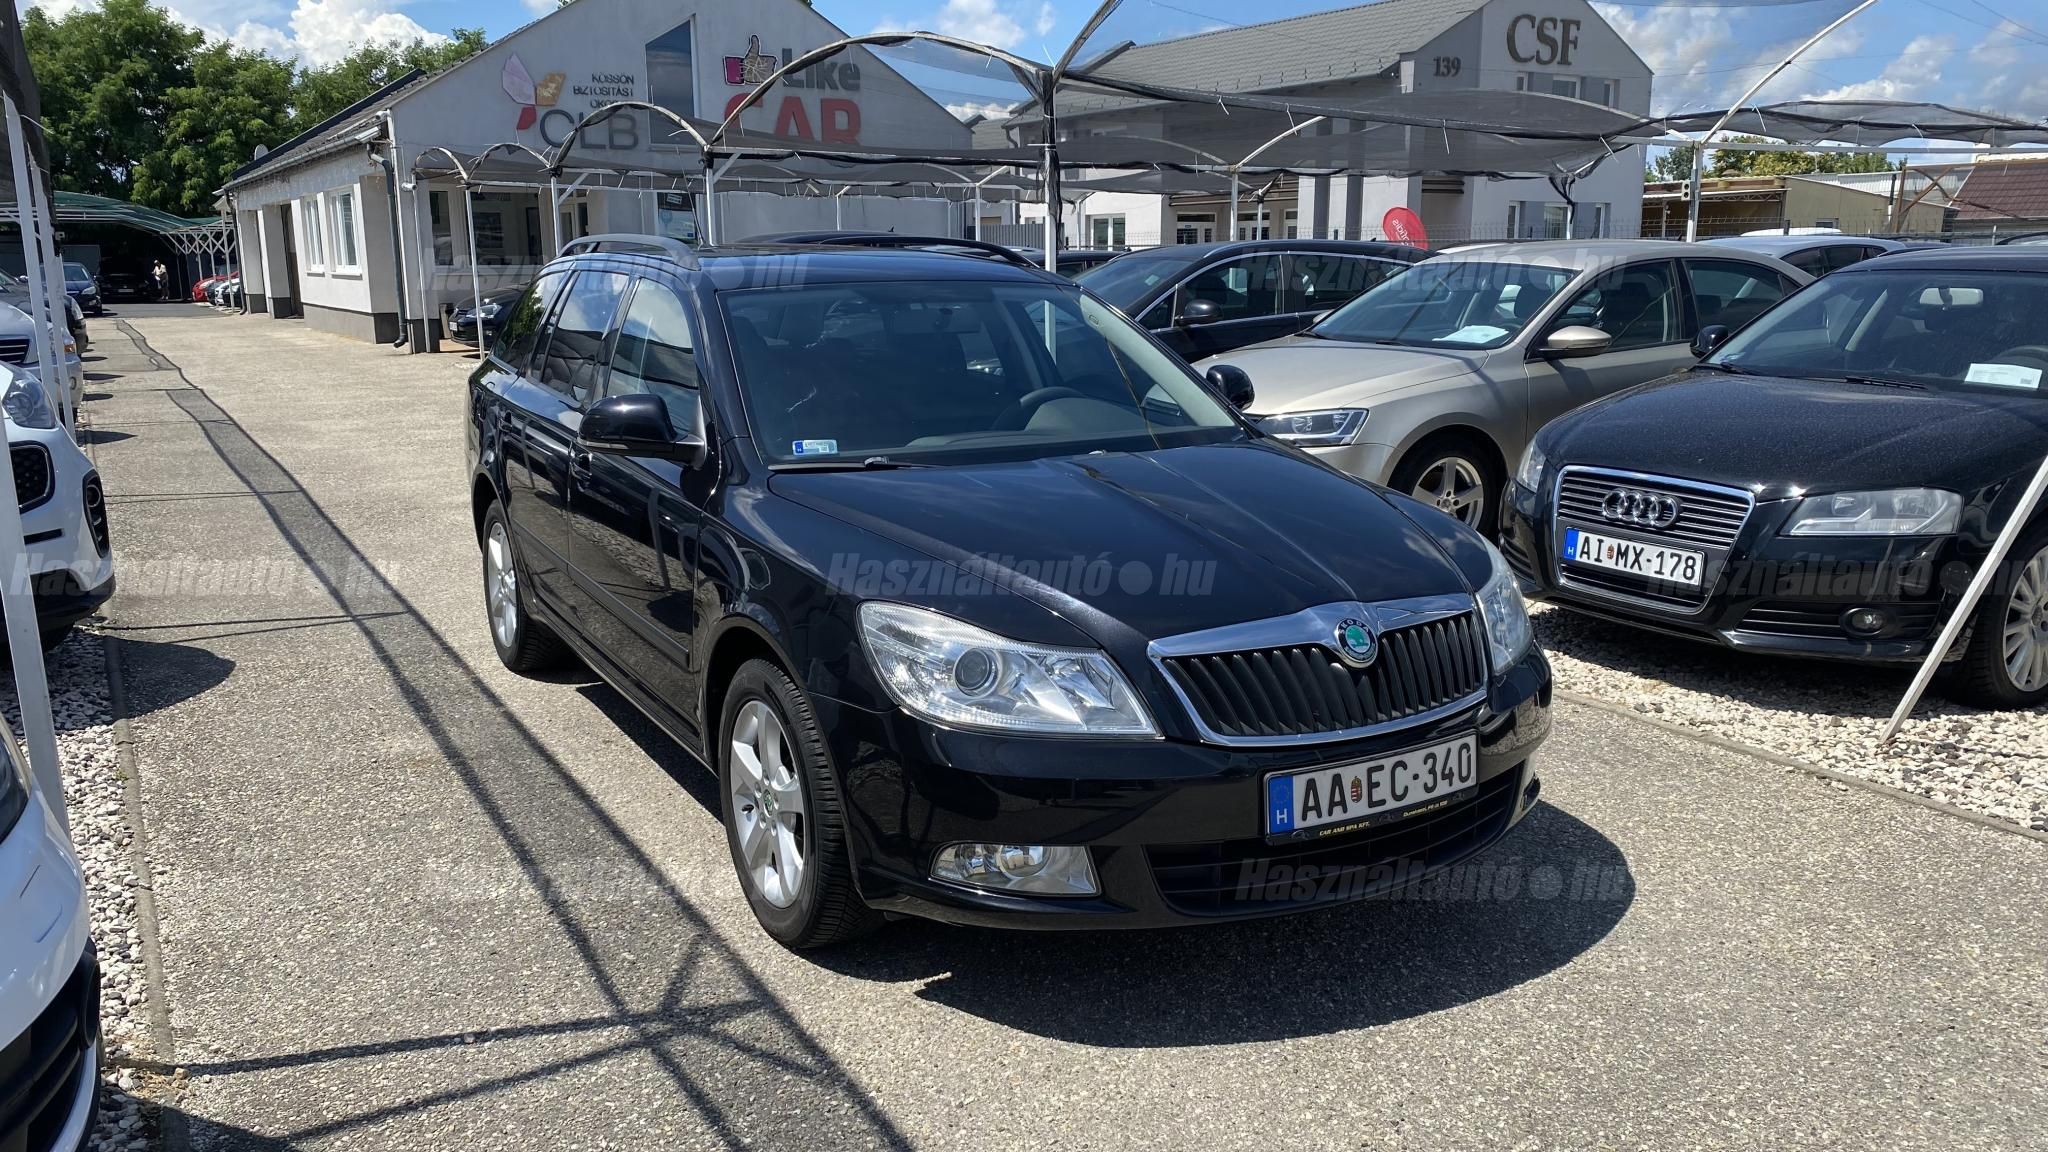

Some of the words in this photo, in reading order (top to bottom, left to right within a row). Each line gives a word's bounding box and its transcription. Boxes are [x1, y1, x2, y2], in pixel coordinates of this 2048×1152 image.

[1506, 13, 1581, 66] CSF
[781, 47, 861, 92] Like
[1432, 56, 1462, 78] 139
[540, 109, 639, 150] CLB
[1579, 535, 1603, 563] AI
[1615, 542, 1697, 581] MX-178
[1276, 808, 1288, 825] H
[1301, 773, 1348, 822] AA
[1366, 742, 1472, 809] EC-340
